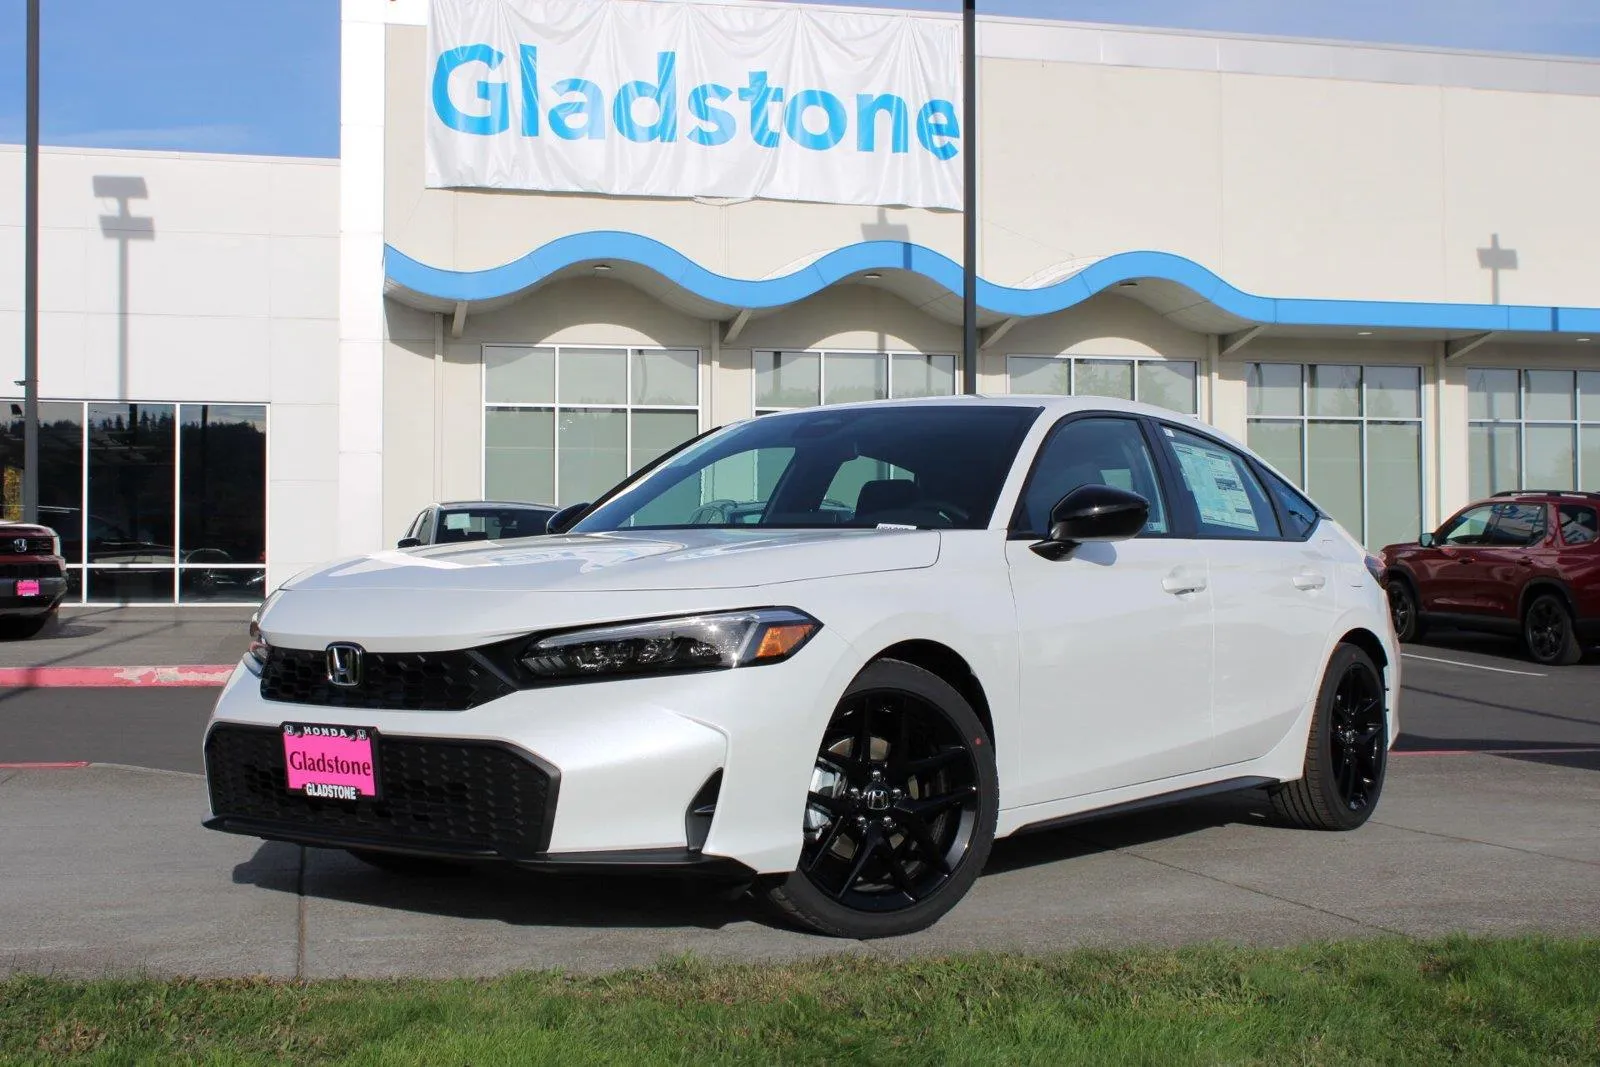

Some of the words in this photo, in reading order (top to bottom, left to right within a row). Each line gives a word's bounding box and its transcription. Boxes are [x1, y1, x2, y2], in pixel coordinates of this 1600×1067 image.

[432, 43, 961, 161] Gladstone
[303, 726, 348, 738] HONDA
[289, 751, 371, 776] Gladstone
[306, 782, 356, 800] GLADSTONE
